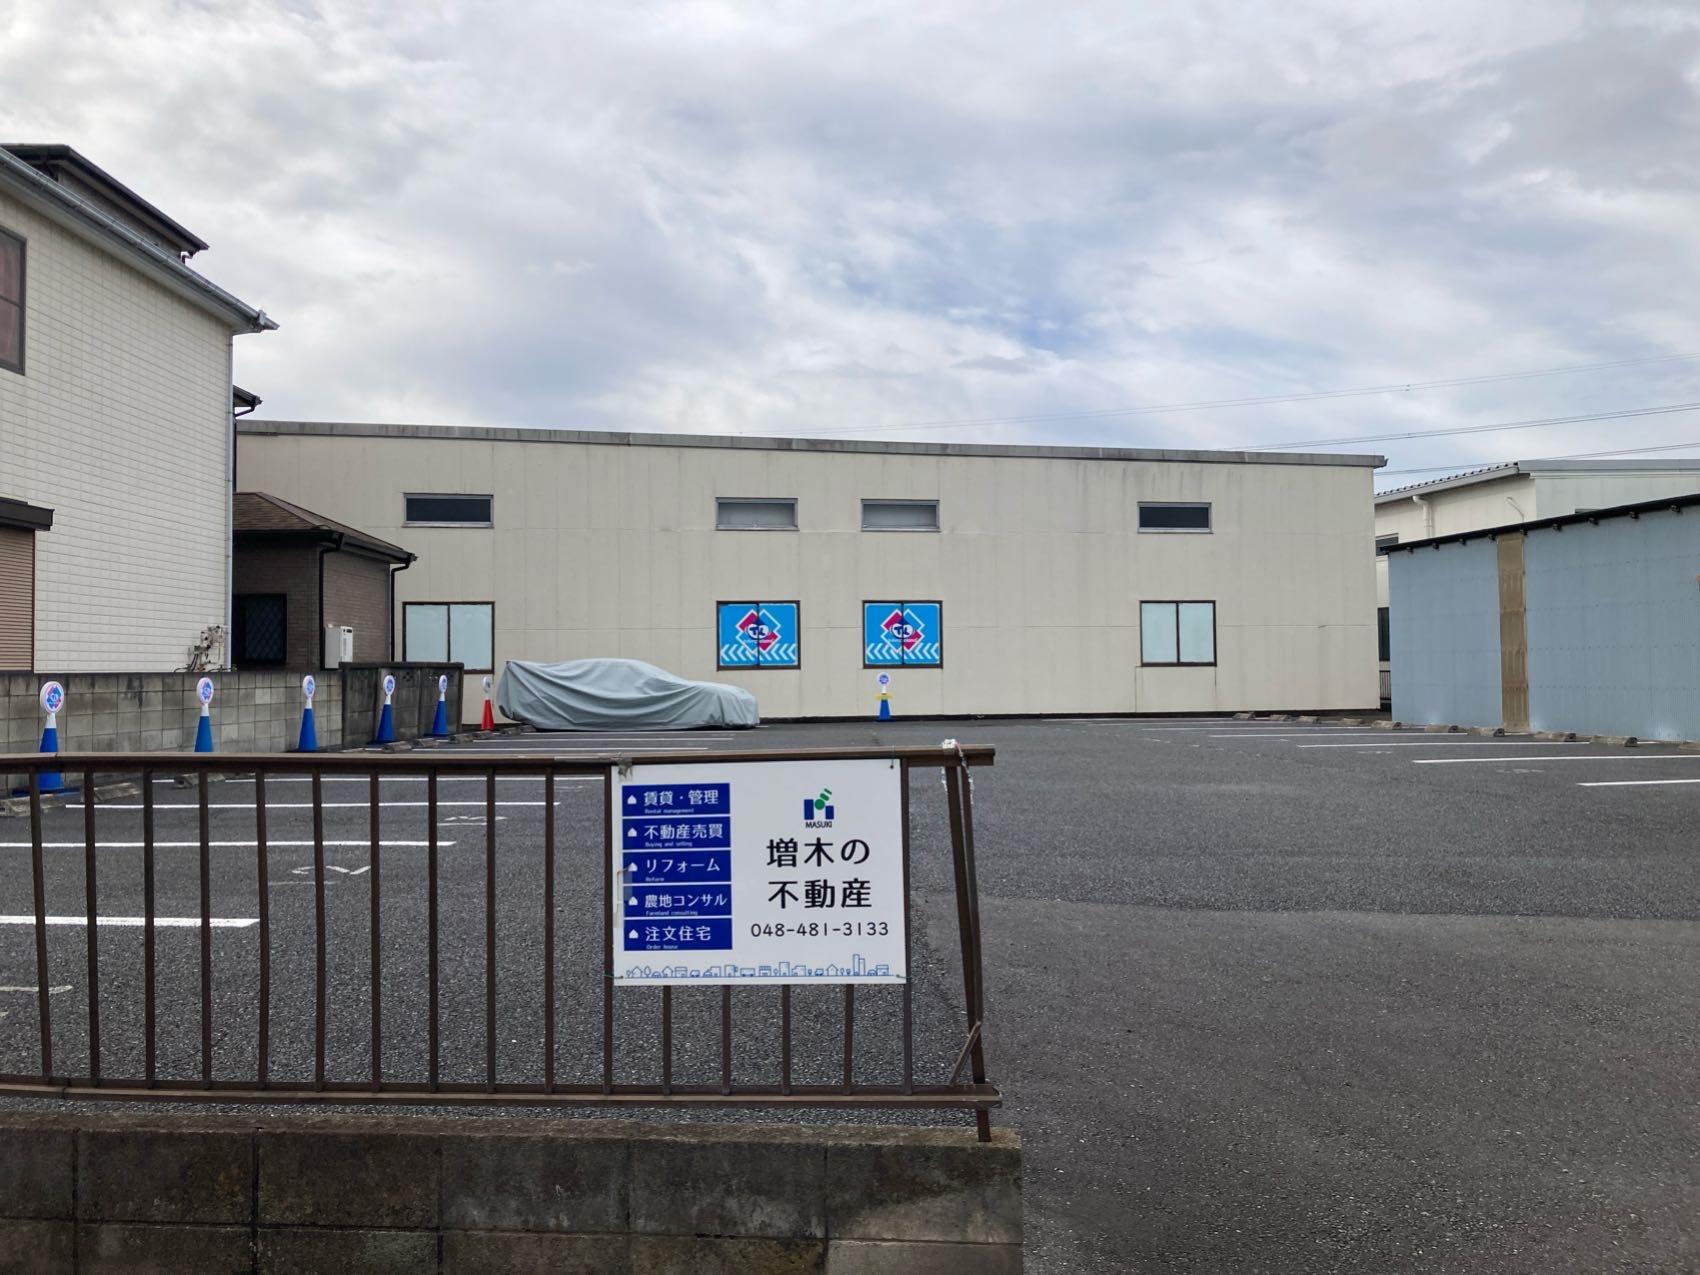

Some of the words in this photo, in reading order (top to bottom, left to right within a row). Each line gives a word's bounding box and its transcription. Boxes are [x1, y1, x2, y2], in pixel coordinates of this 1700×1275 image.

[644, 790, 719, 807] 賃貸・管理
[644, 823, 723, 840] 不動産売買
[805, 820, 833, 829] MASUKI
[766, 837, 870, 868] 増木の
[646, 858, 720, 874] リフォーム
[644, 893, 728, 908] 農地コンサル
[768, 877, 873, 909] 不動産
[645, 926, 711, 942] 注文住宅
[751, 921, 889, 938] 048-481-3133
